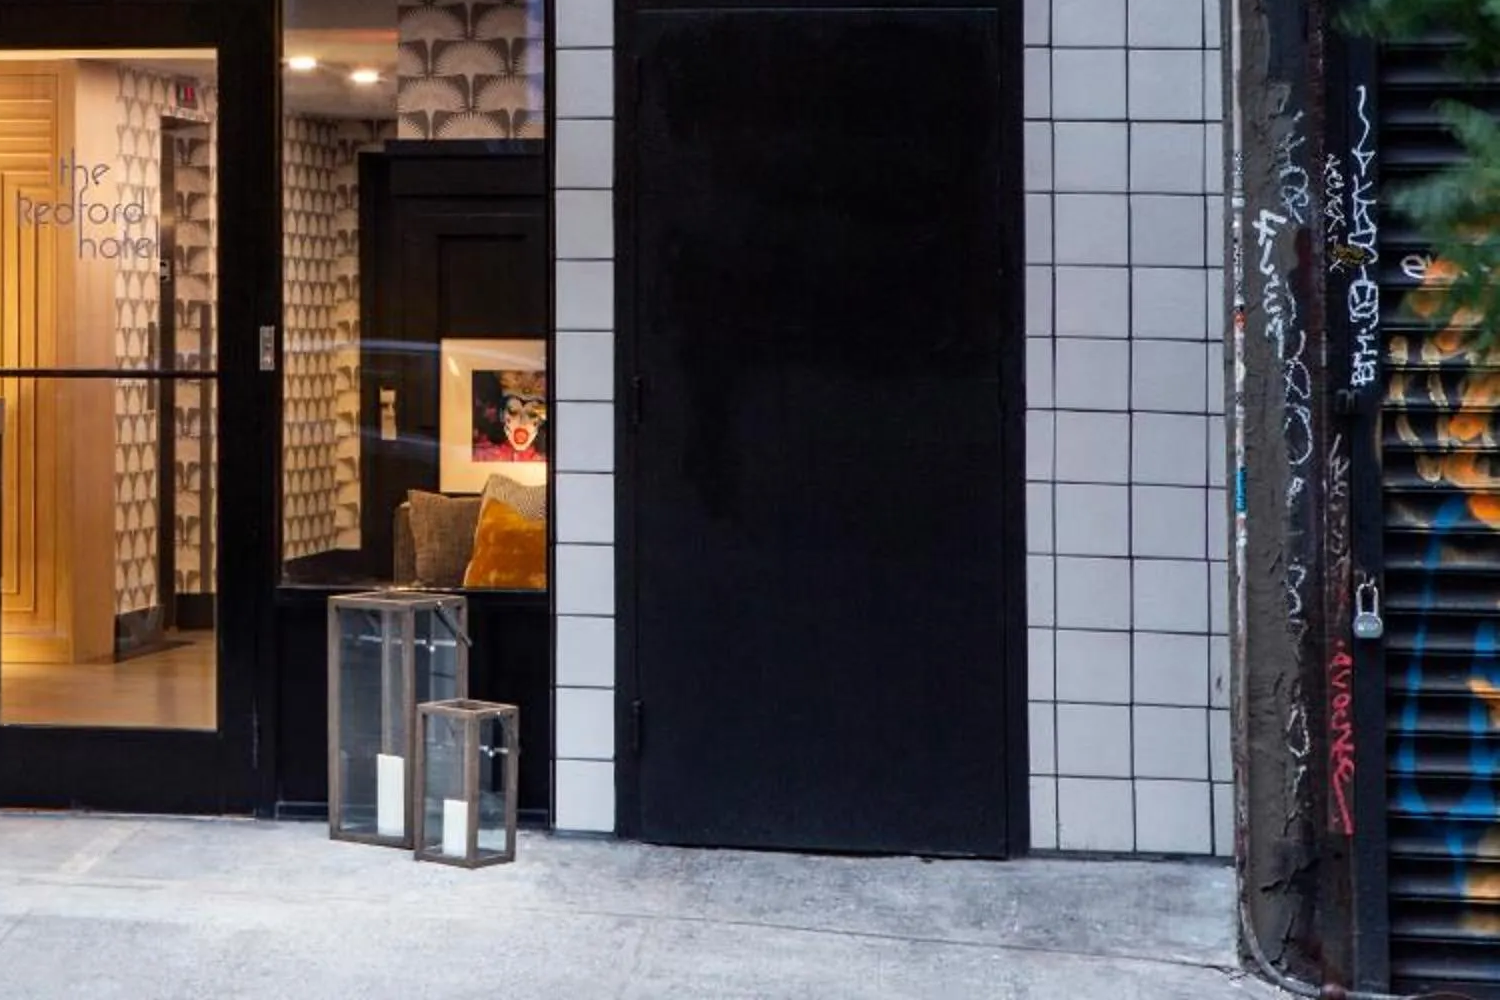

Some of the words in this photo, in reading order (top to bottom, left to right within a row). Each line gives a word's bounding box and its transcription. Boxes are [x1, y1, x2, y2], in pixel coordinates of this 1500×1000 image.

[59, 148, 111, 187] the
[17, 190, 146, 225] Redford
[78, 216, 160, 260] hotel
